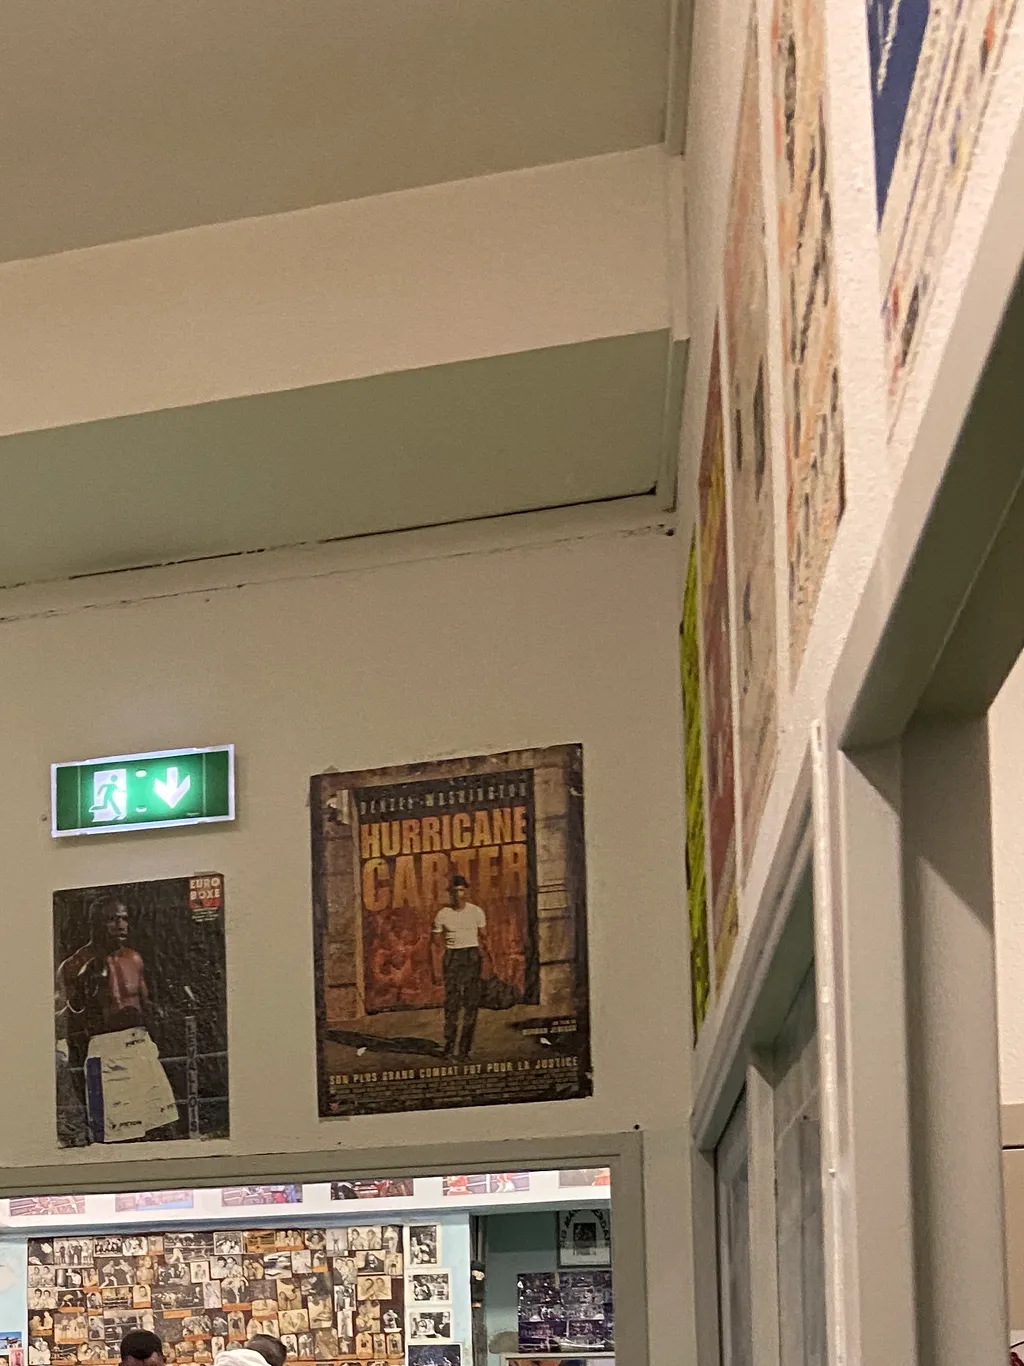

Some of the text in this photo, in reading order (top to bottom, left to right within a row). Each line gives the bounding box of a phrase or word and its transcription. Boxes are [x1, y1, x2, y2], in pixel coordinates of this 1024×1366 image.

[361, 805, 527, 859] HURRICANE
[189, 878, 220, 889] EURO
[361, 843, 528, 912] CARTER
[189, 889, 220, 900] BOXE
[329, 1075, 349, 1085] SON
[353, 1073, 377, 1083] PLUS
[382, 1069, 414, 1081] GRAND
[420, 1066, 459, 1078] COMBAT
[464, 1064, 481, 1074] FUT
[486, 1062, 512, 1073] POUR
[535, 1056, 579, 1069] JUSTICE
